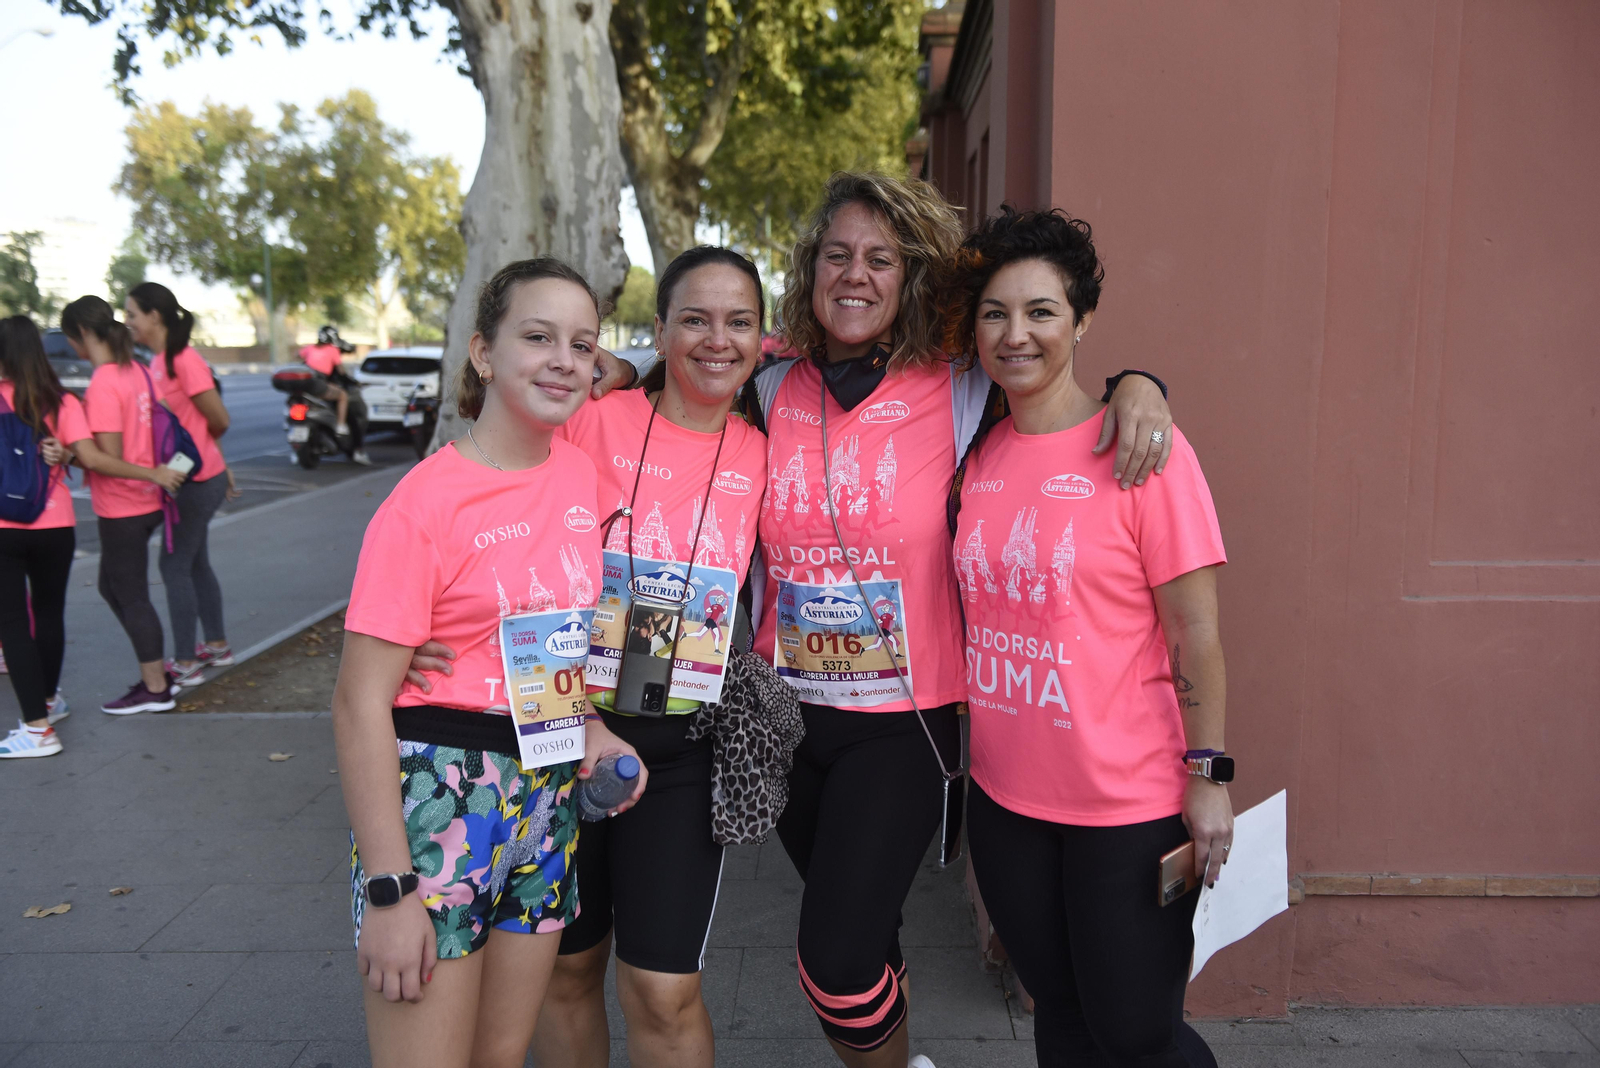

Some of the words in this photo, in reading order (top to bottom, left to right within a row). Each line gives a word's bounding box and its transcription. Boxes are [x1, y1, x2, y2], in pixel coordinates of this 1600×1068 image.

[777, 406, 822, 426] OYSHO
[613, 455, 672, 480] OYSHO
[1043, 481, 1090, 496] ASTURIANA
[474, 521, 531, 549] OYSHO
[789, 546, 896, 566] DORSAL
[603, 569, 622, 580] UMA
[634, 580, 691, 600] ASTURIANA
[804, 606, 859, 619] ASTURIANA
[512, 636, 538, 647] SUMA
[806, 631, 862, 655] 016
[966, 624, 980, 644] U
[982, 627, 1072, 665] DORSAL
[586, 662, 618, 678] OYSH
[674, 659, 693, 670] UJER
[822, 660, 851, 671] 5373
[554, 665, 585, 696] 01
[799, 670, 829, 680] CARRERA
[830, 673, 840, 681] DE
[841, 673, 852, 681] LA
[853, 671, 879, 681] MUJER
[966, 646, 1071, 713] SUMA
[485, 678, 508, 701] T
[860, 686, 900, 697] Santander
[978, 700, 987, 708] DE
[988, 701, 997, 710] LA
[997, 704, 1018, 716] MUJER
[544, 717, 579, 731] CARRERA
[1053, 718, 1072, 730] 2022
[533, 737, 574, 756] OYSHO
